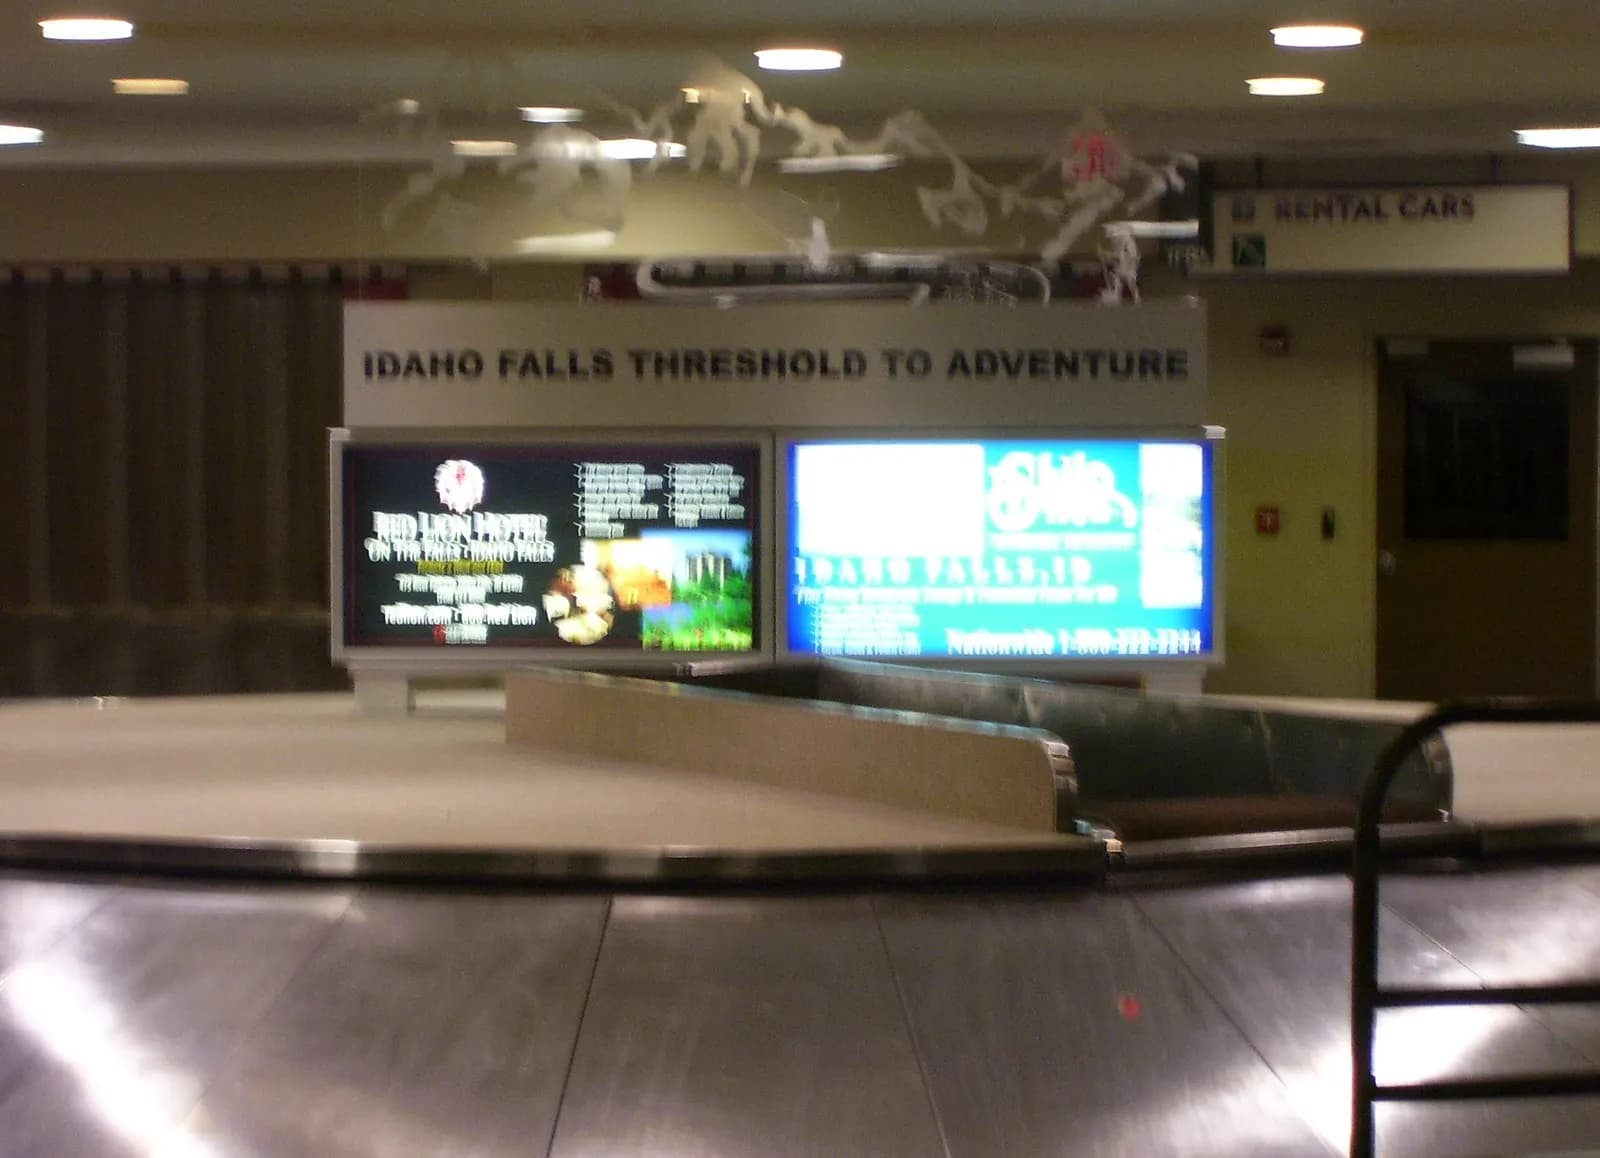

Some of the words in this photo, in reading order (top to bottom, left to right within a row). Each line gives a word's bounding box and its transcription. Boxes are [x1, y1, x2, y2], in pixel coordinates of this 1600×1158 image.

[1275, 193, 1388, 222] RENTAL
[1399, 192, 1476, 219] CARS
[363, 350, 484, 380] IDAHO
[498, 350, 614, 380] FALLS
[628, 350, 867, 380] THRESHOLD
[883, 350, 932, 380] TO
[947, 350, 1189, 381] ADVENTURE
[373, 511, 417, 541] RED
[417, 512, 473, 542] LION
[473, 512, 549, 542] HOTEL
[364, 537, 391, 562] ON
